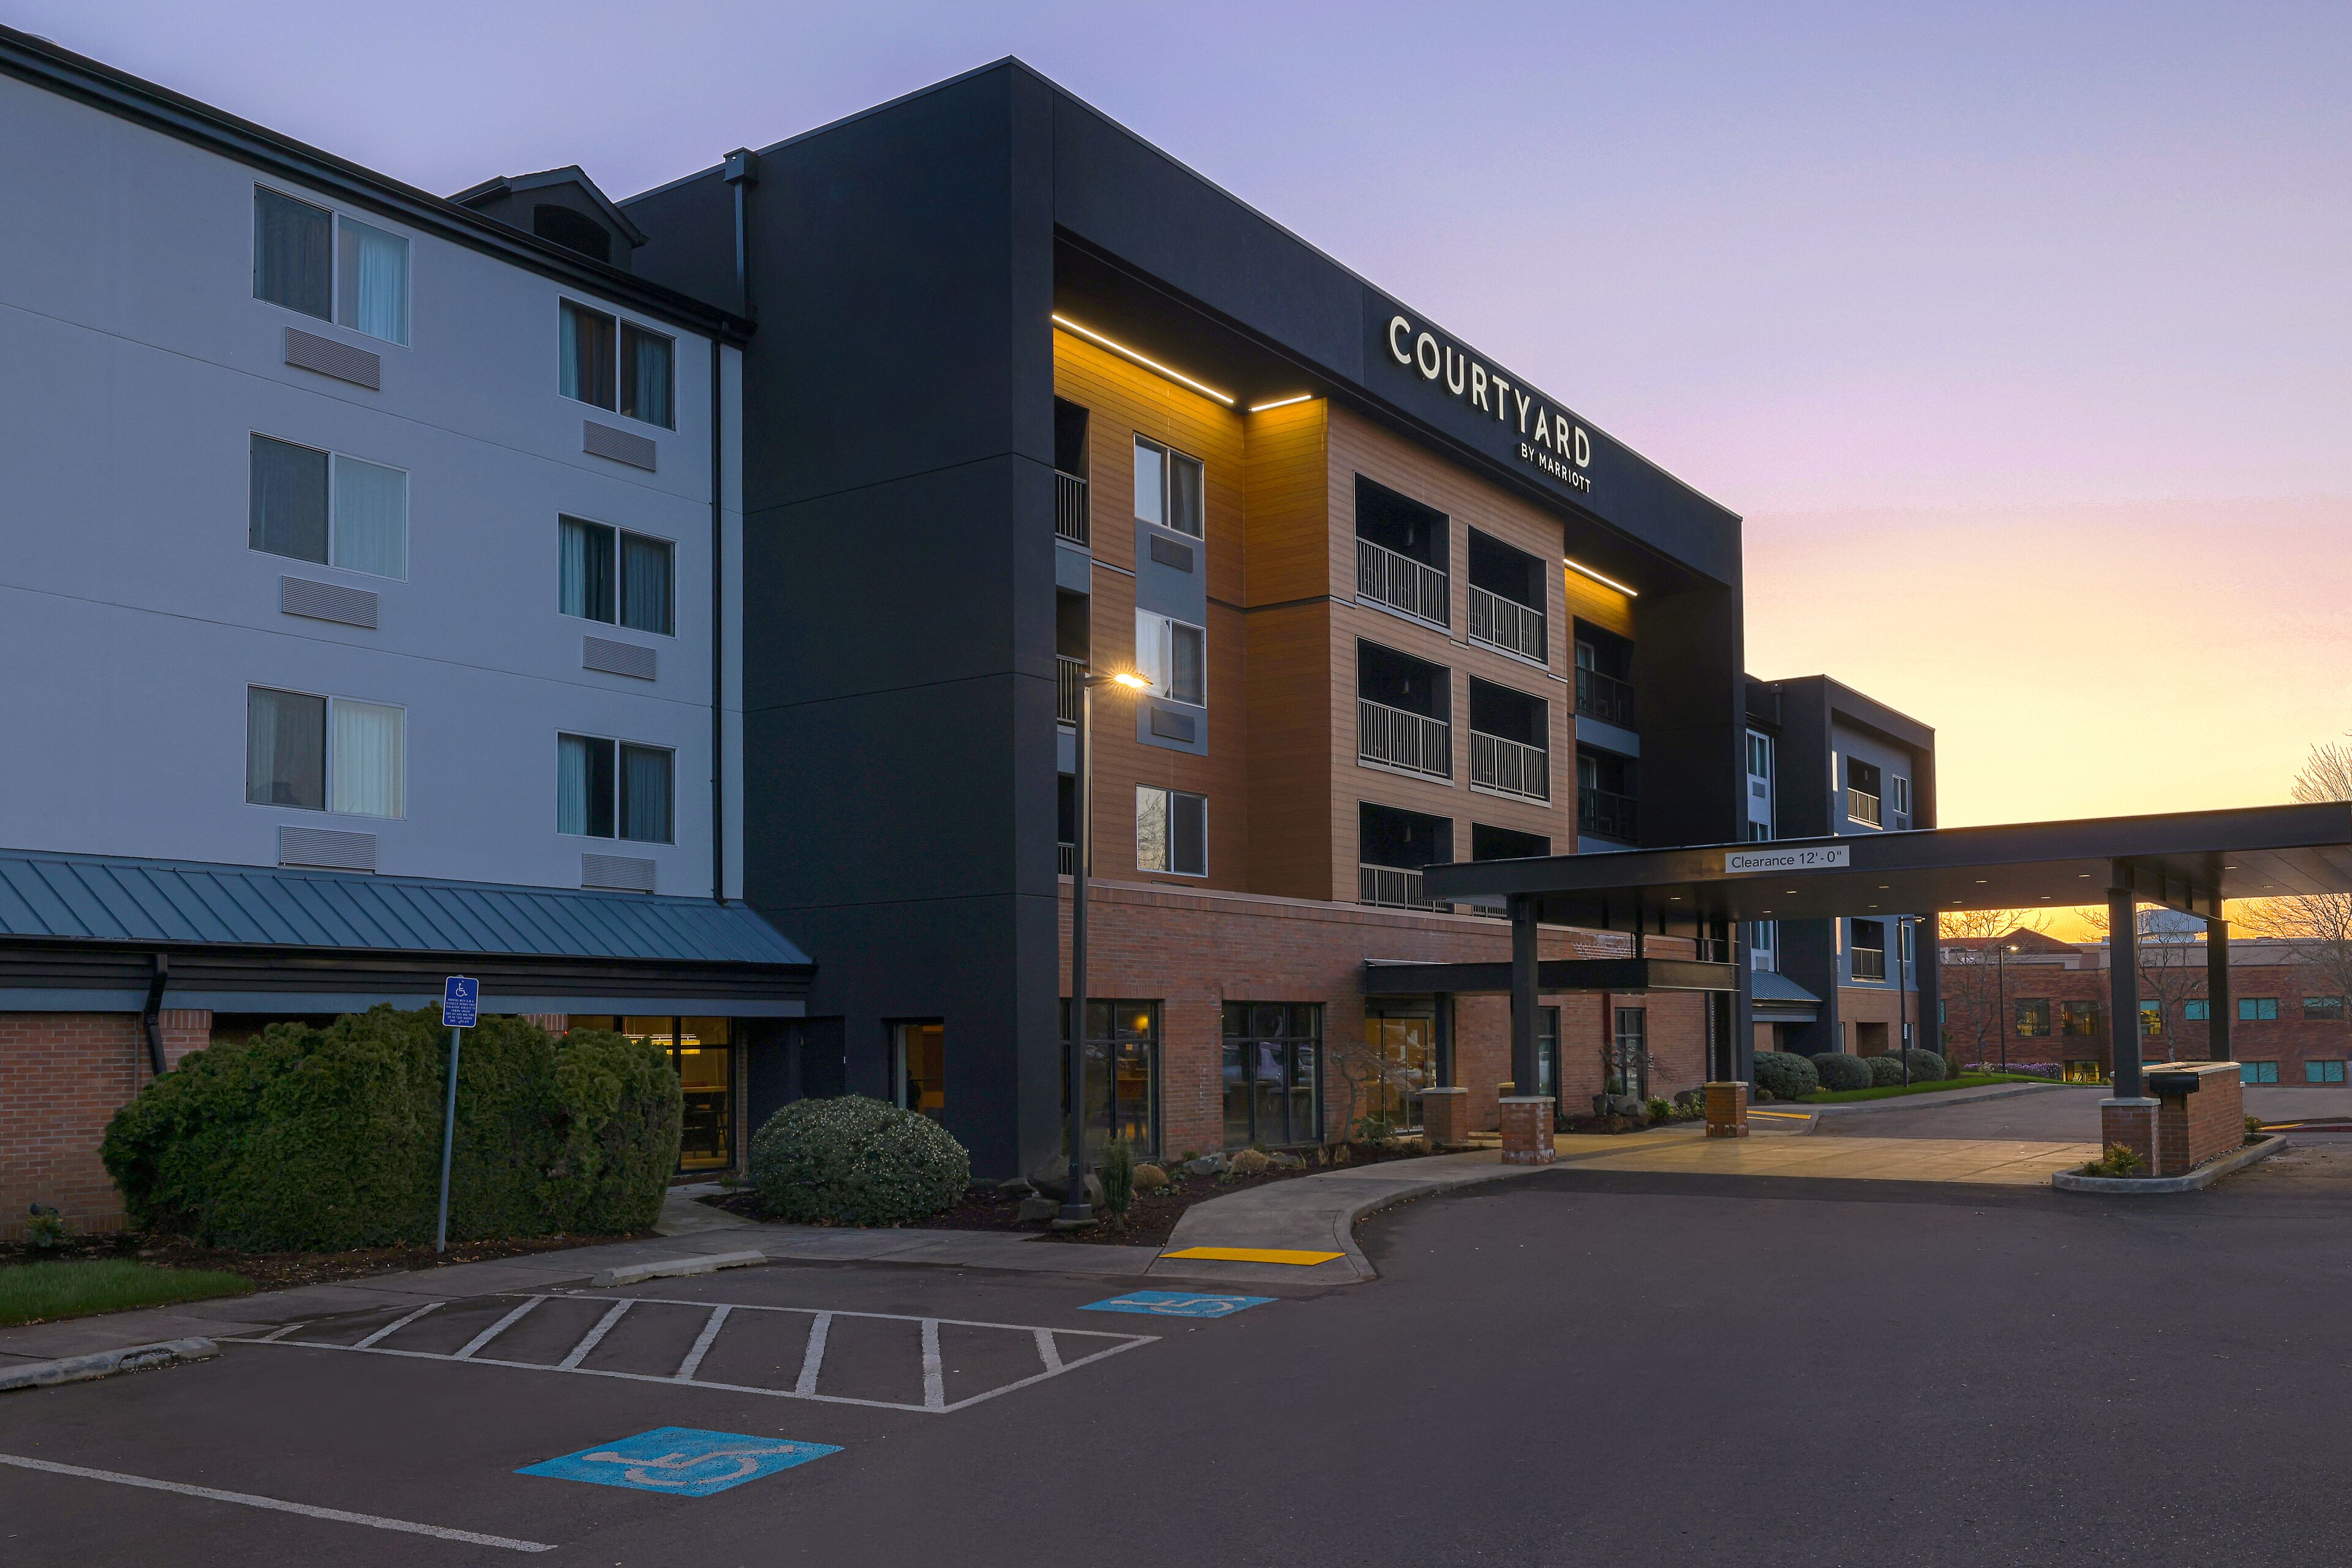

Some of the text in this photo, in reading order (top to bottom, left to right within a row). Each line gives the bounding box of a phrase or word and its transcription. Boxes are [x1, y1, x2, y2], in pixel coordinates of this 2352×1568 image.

[1389, 315, 1591, 468] COURTYARD
[1521, 442, 1591, 493] BY MARRIOTT
[1732, 856, 1795, 869] Clearance
